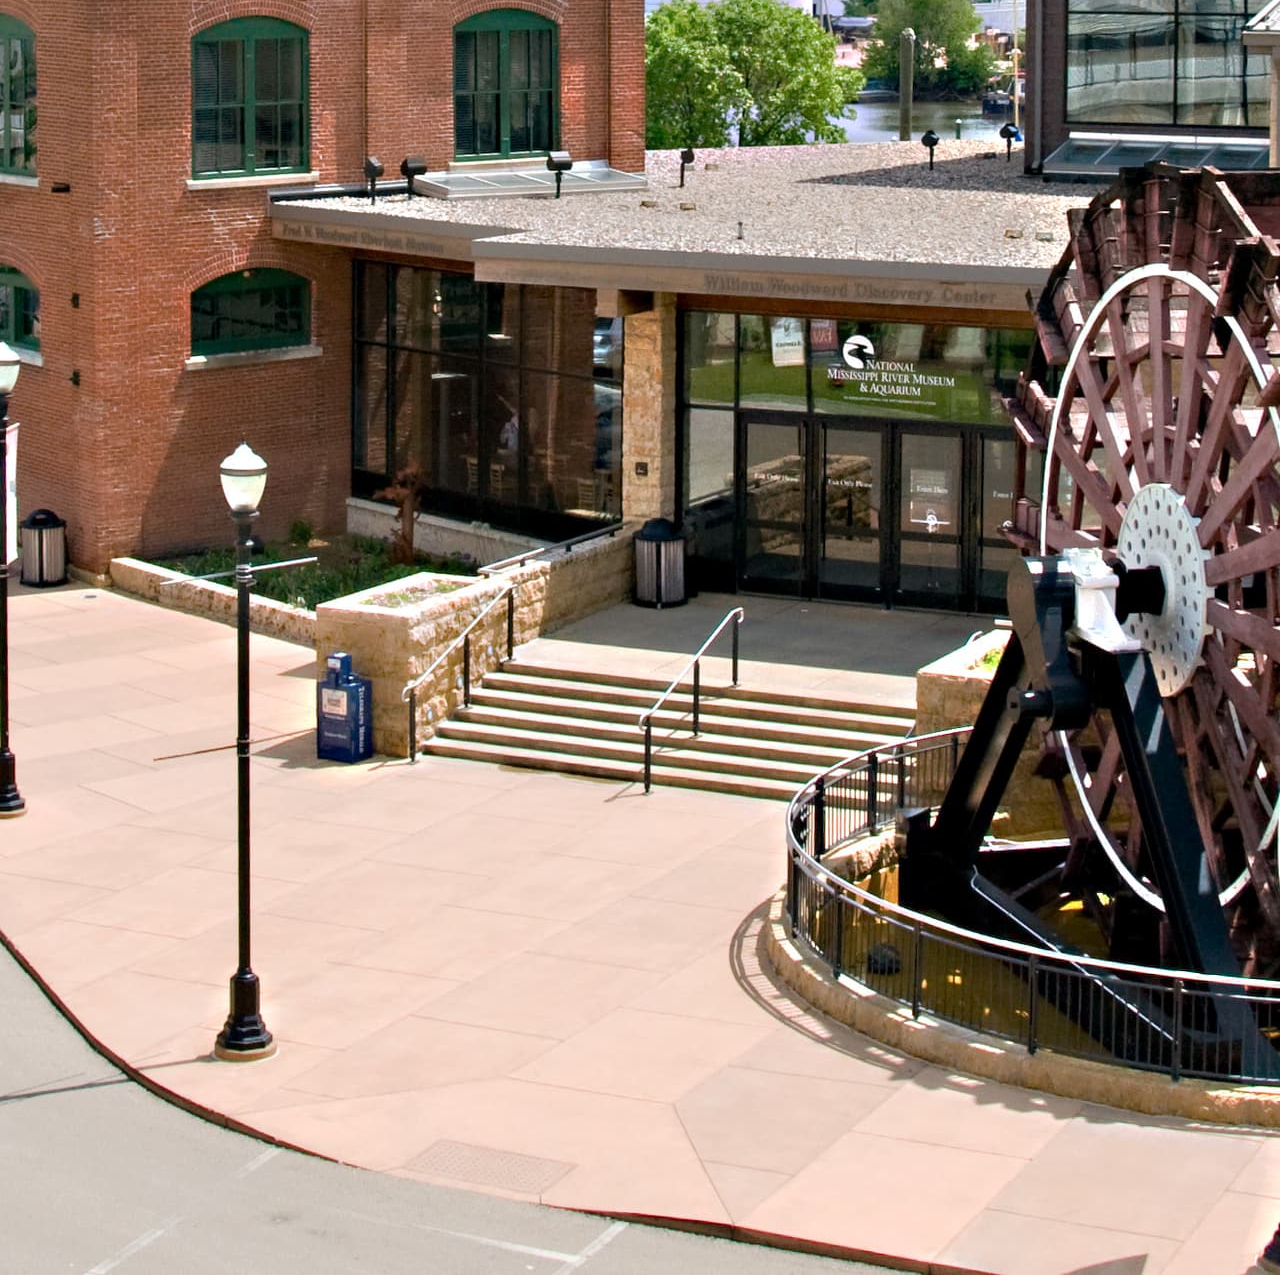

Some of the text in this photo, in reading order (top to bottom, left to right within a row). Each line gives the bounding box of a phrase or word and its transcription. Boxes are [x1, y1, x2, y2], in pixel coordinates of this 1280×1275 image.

[703, 275, 997, 304] William Woodward Discovery Center
[866, 359, 916, 373] NATIONAL
[827, 368, 955, 387] MISSISSIPPI RIVER MUSEUM
[859, 383, 921, 397] & AQUARIUM
